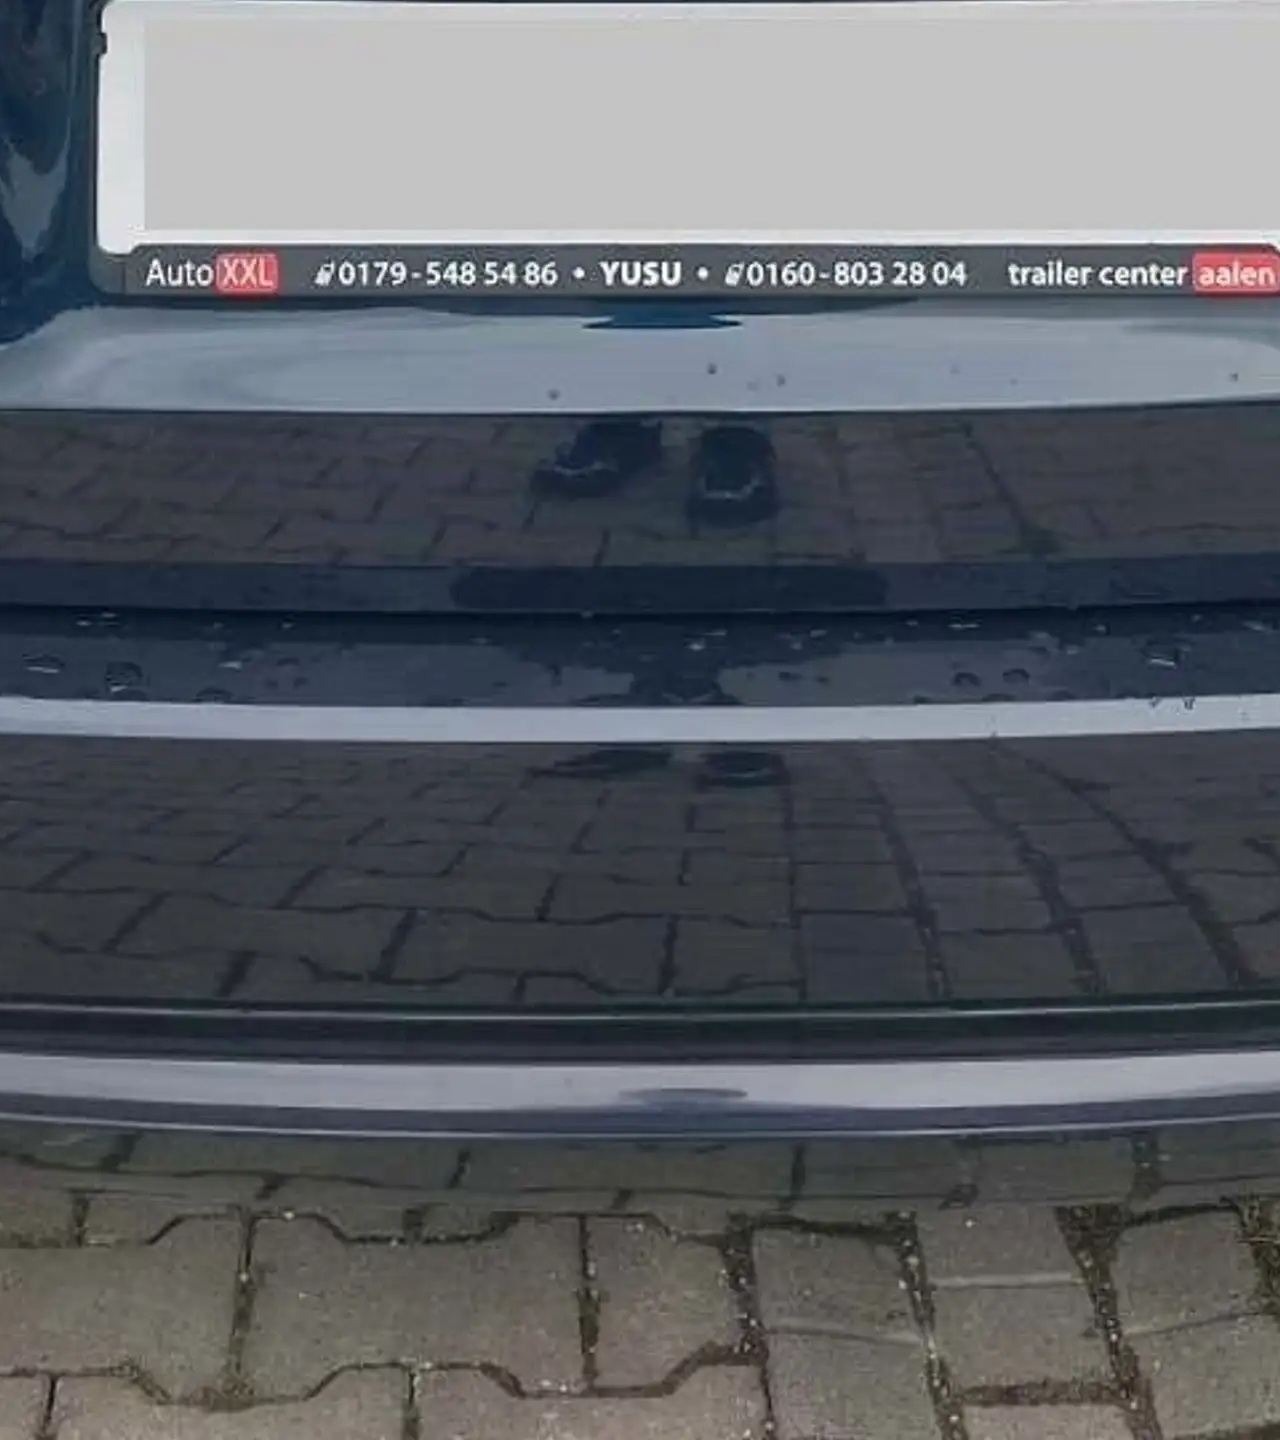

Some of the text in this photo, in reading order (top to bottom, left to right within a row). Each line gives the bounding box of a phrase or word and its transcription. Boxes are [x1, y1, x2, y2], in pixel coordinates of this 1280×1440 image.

[483, 261, 518, 287] 54
[523, 261, 559, 287] 86
[598, 260, 682, 287] YUSU
[891, 261, 927, 287] 28
[931, 261, 968, 287] 04
[1007, 259, 1278, 287] trailer center aalen
